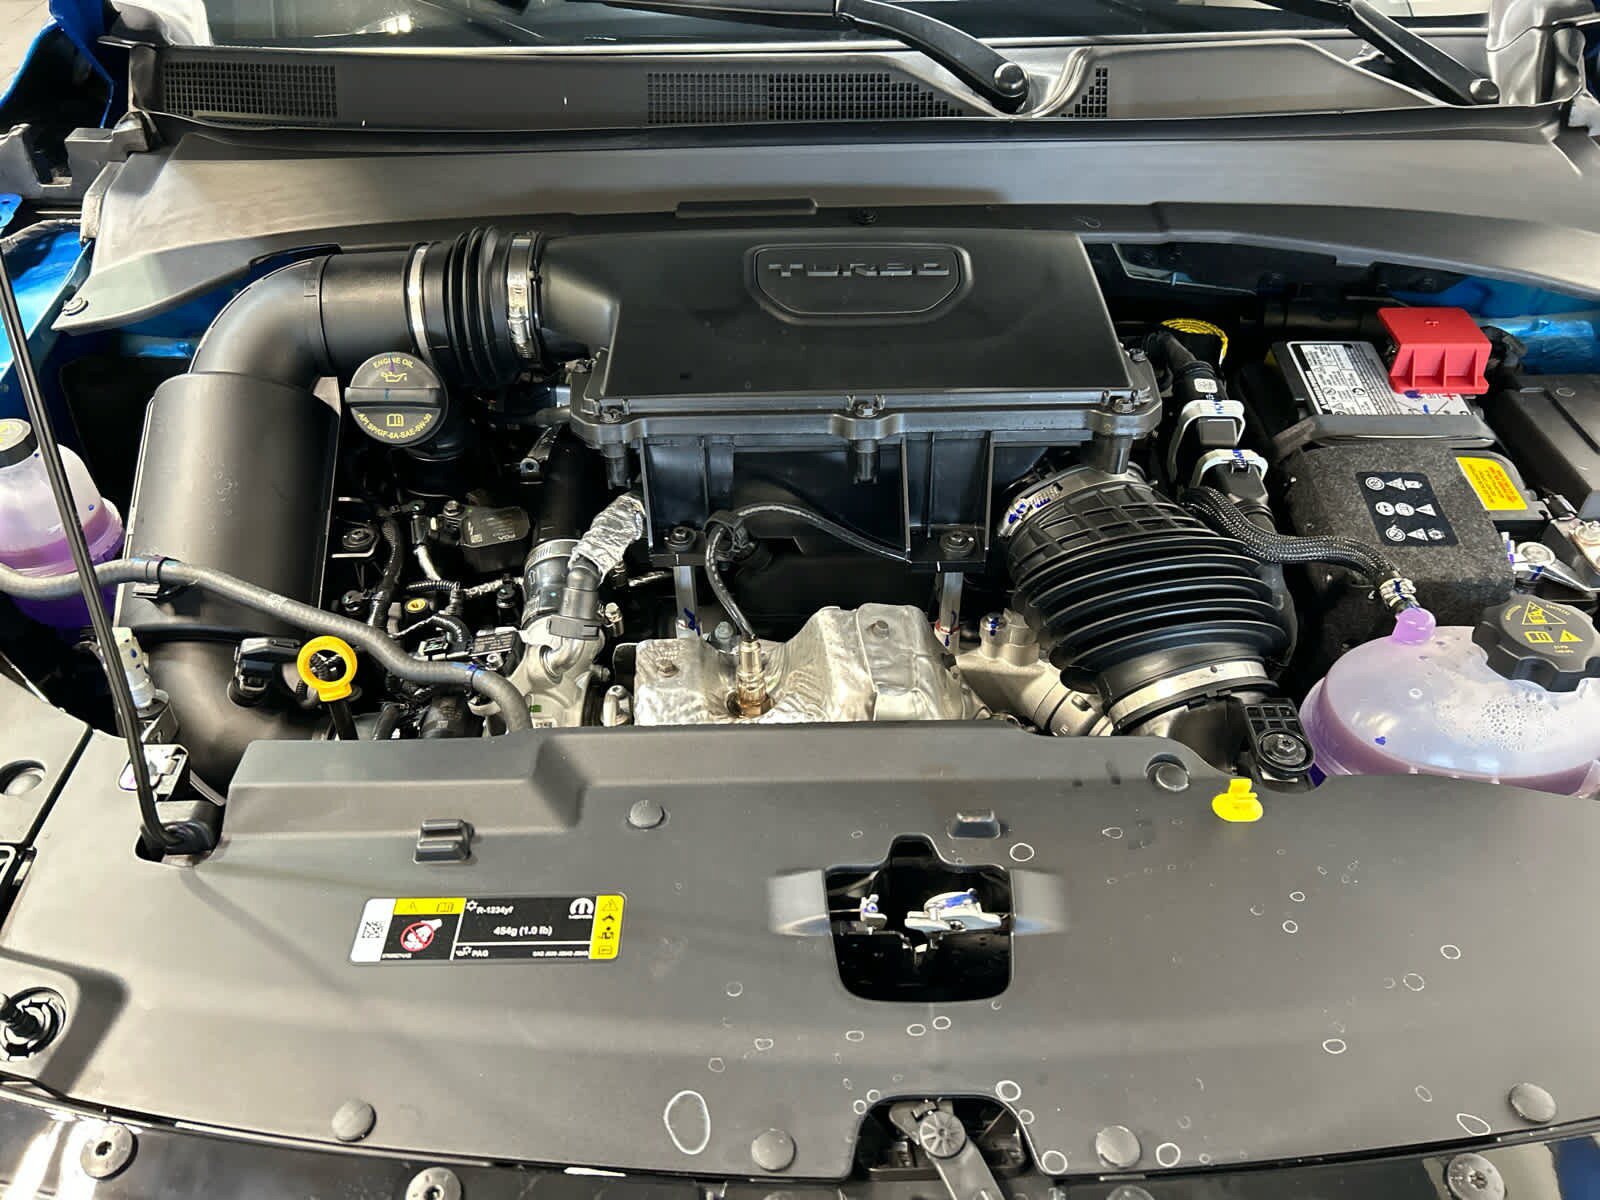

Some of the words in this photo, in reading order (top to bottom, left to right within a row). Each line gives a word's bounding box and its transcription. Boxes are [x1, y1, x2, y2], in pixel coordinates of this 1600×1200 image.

[768, 263, 949, 277] TURBO
[373, 357, 400, 368] ENGINE
[402, 358, 414, 369] OIL
[476, 905, 514, 915] R-1234yf
[493, 926, 518, 937] 454g
[519, 925, 538, 936] (1.0
